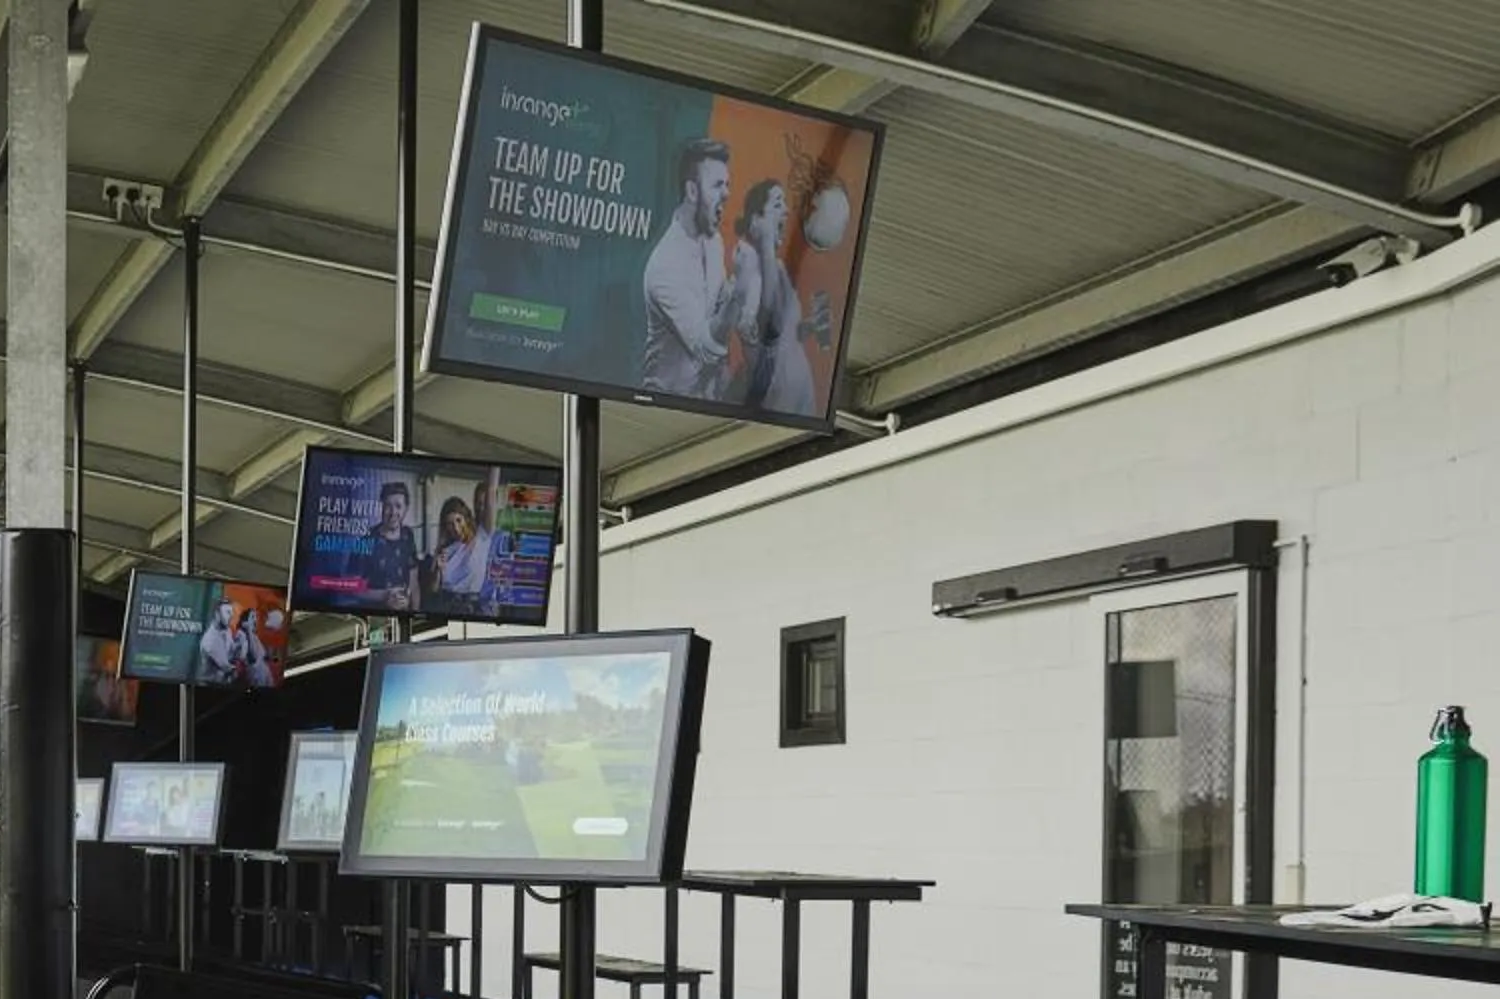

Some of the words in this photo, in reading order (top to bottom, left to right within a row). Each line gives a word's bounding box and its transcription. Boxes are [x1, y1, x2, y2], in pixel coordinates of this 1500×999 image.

[494, 136, 550, 179] TEAM
[554, 149, 583, 185] UP
[586, 157, 626, 195] FOR
[489, 176, 528, 217] THE
[529, 184, 652, 241] SHOWDOWN
[318, 495, 349, 516] PLAY
[351, 498, 383, 518] WITH
